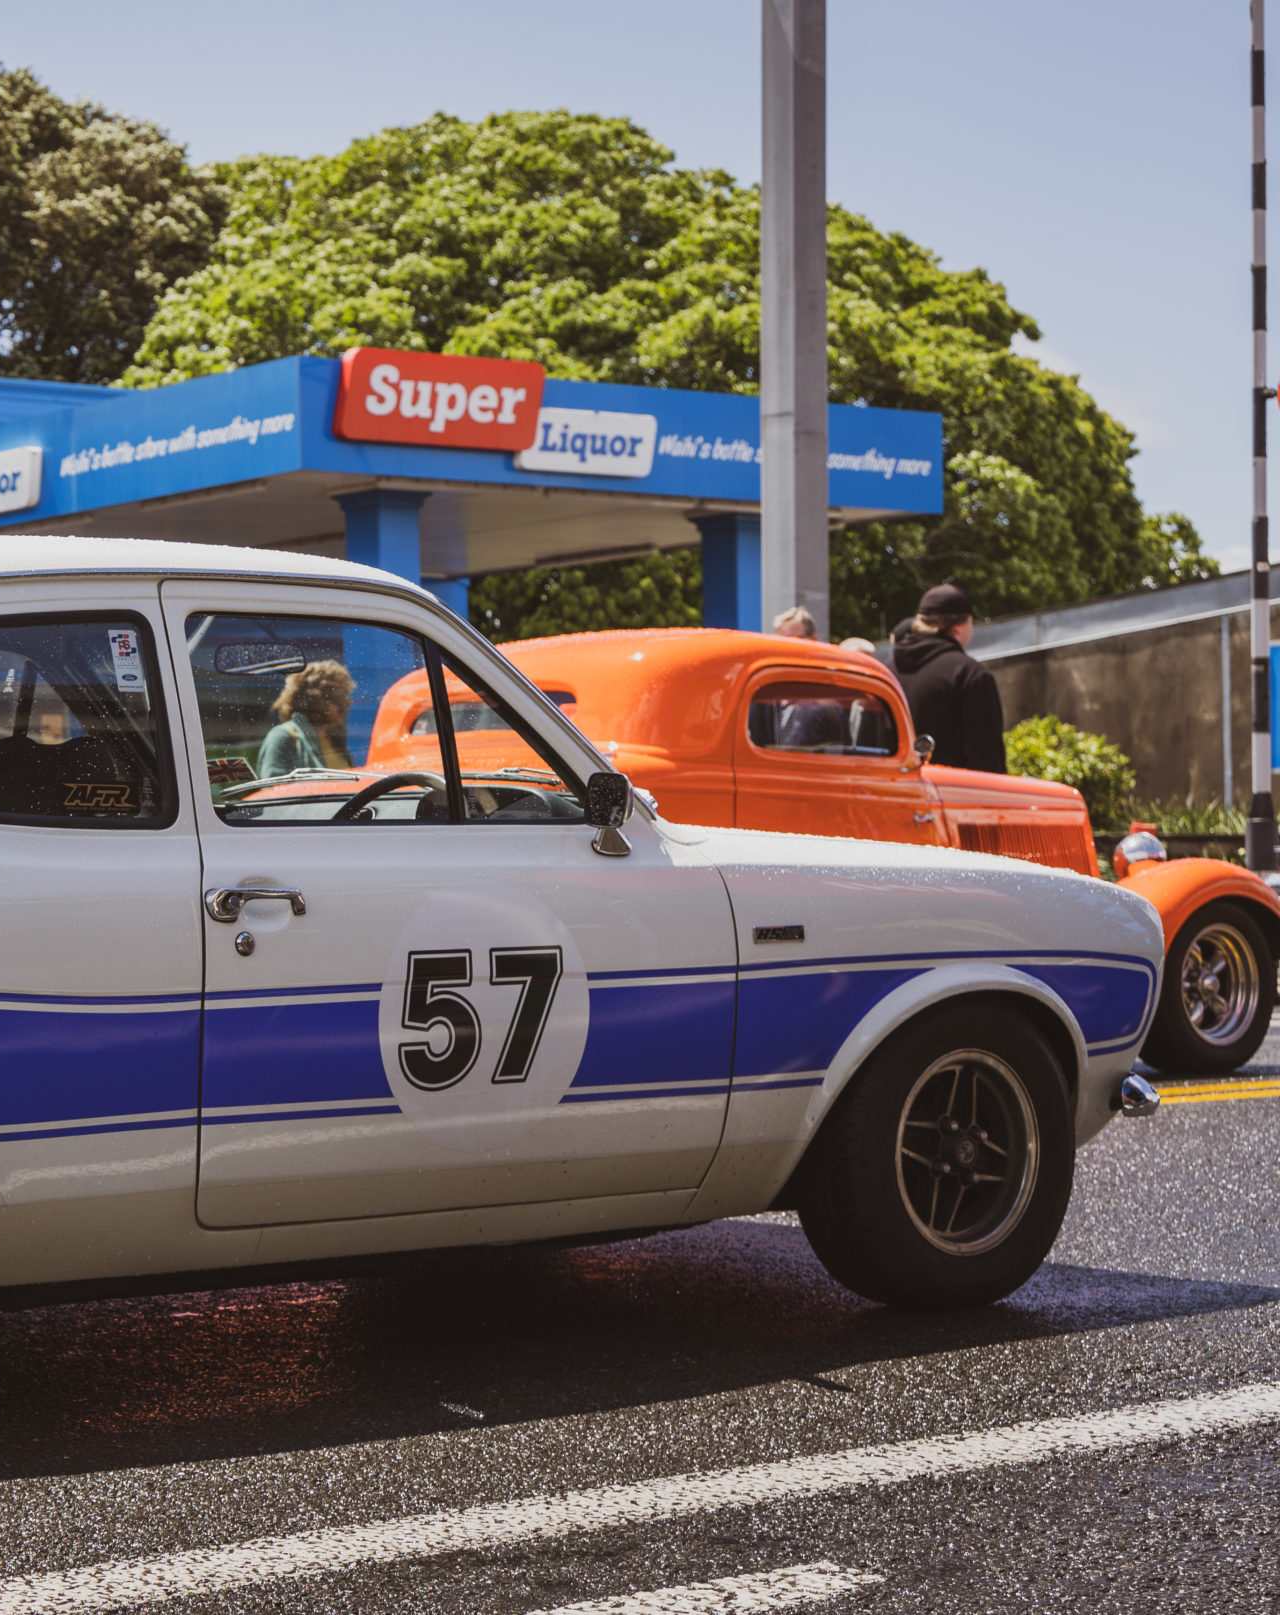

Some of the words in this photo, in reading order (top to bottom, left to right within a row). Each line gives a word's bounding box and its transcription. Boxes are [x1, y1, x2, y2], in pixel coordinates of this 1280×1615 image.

[365, 363, 526, 433] Super
[135, 435, 169, 461] store
[169, 424, 196, 455] with
[196, 415, 261, 449] something
[260, 413, 296, 436] more
[538, 422, 643, 463] Liquor
[712, 436, 754, 463] bottle
[826, 447, 896, 480] something
[895, 457, 933, 477] more
[61, 783, 137, 807] AFR
[398, 945, 563, 1092] 57
